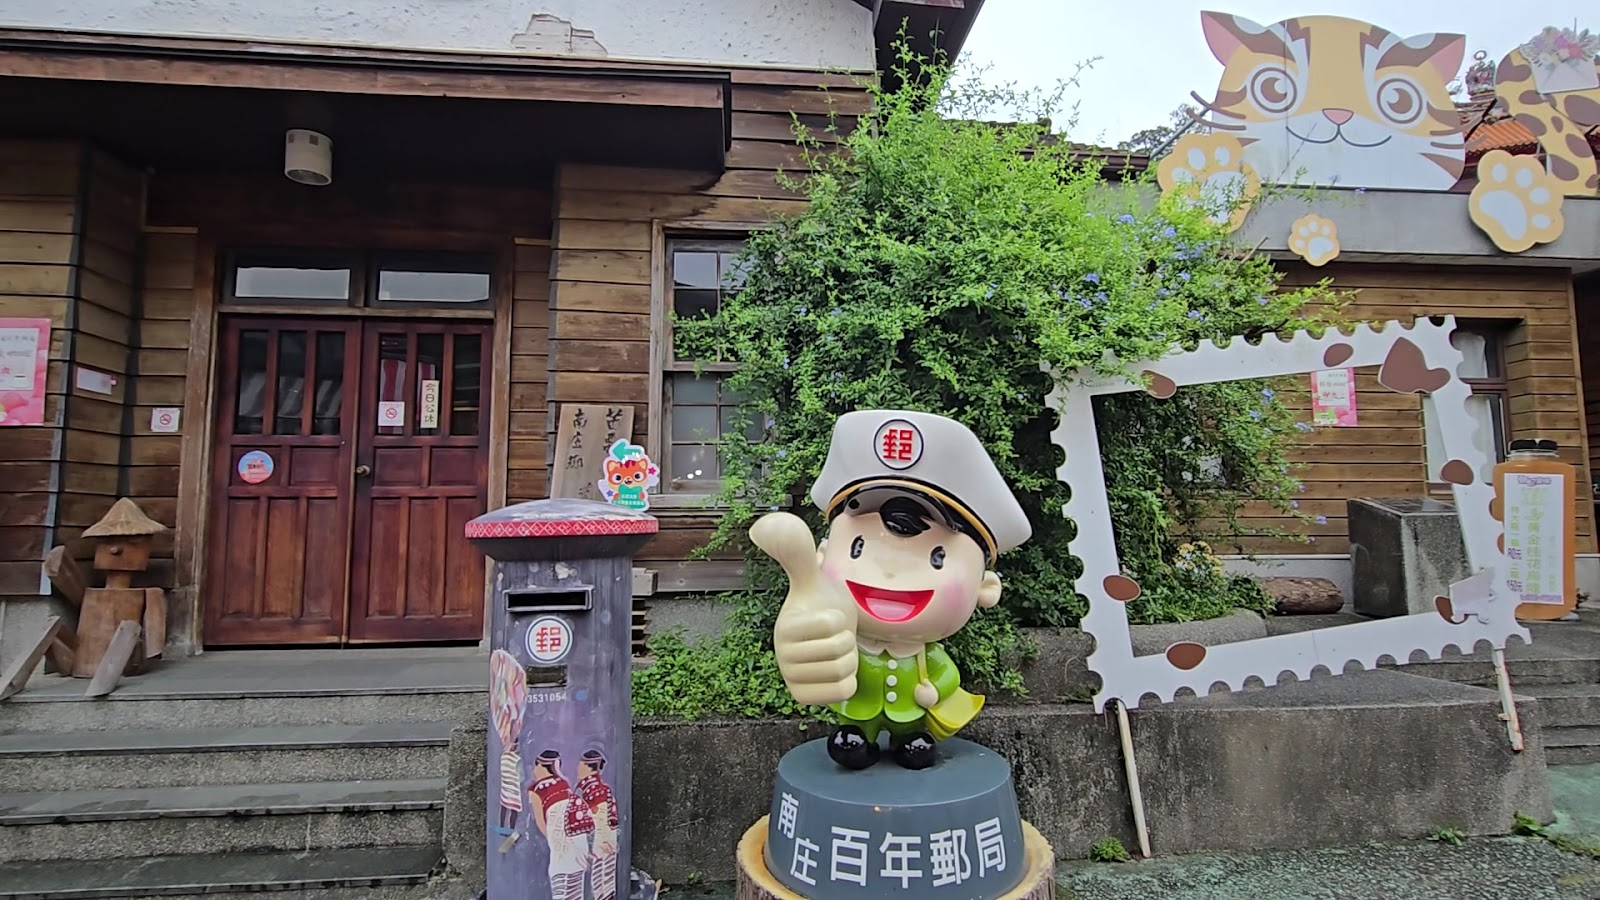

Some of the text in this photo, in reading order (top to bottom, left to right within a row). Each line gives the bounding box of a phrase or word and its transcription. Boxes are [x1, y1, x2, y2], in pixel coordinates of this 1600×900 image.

[425, 383, 436, 423] 今日公休
[882, 428, 914, 461] 郵
[536, 627, 561, 653] 郵
[777, 791, 1007, 889] 南庄百年郵局
